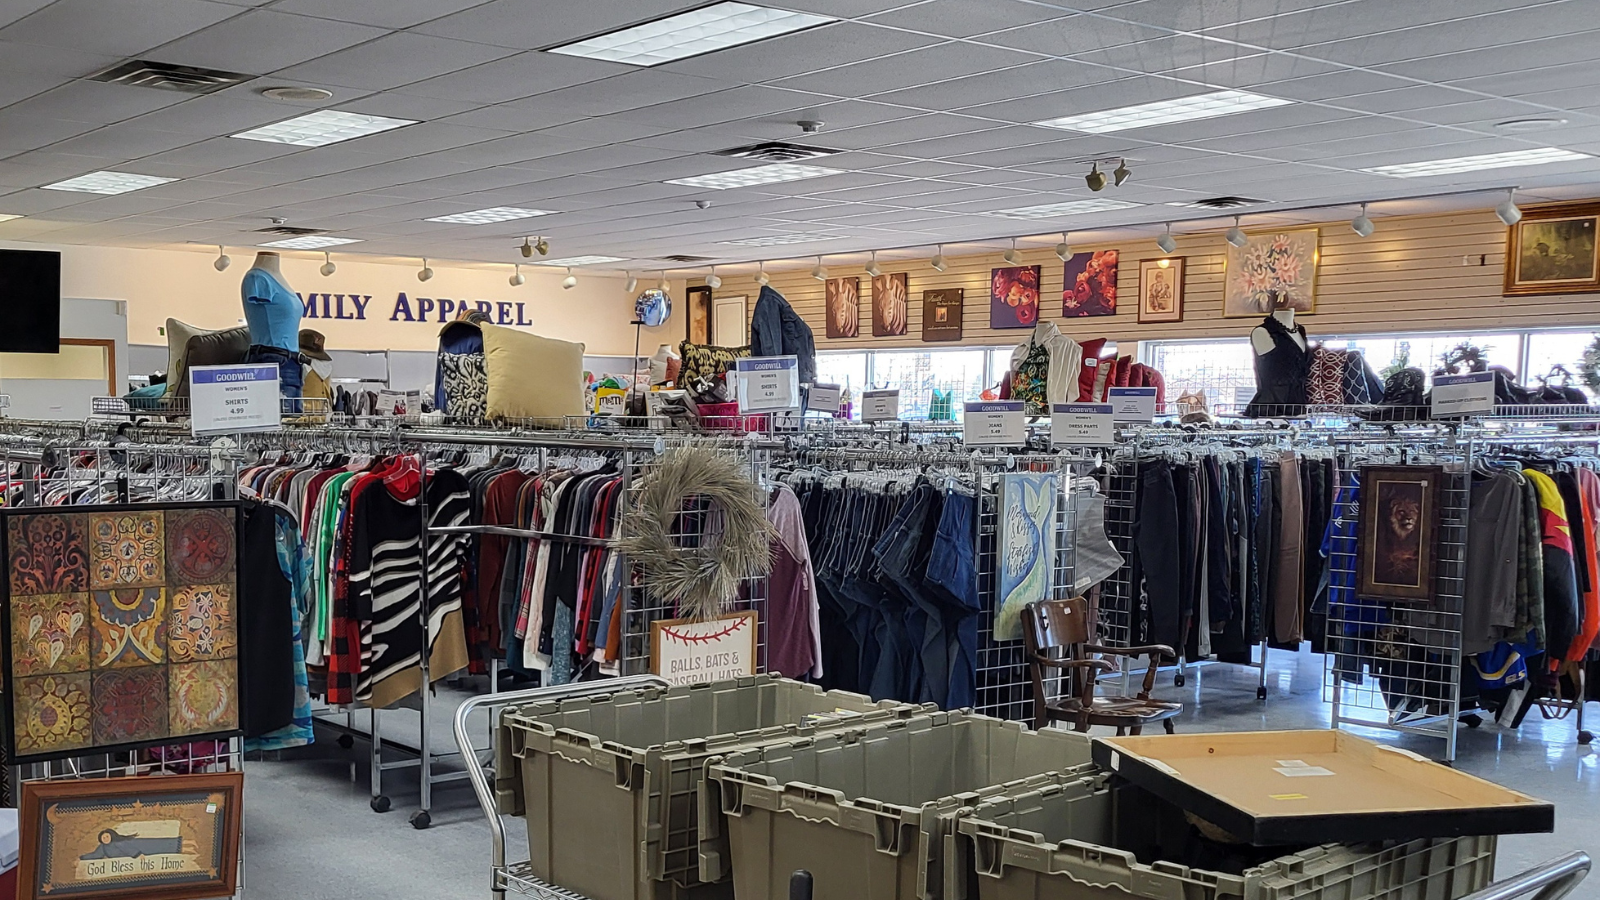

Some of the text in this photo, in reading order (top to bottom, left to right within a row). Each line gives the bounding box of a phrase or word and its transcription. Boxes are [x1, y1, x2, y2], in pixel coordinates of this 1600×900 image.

[296, 292, 533, 326] MILY APPAREL
[216, 372, 256, 382] GOODWILL
[225, 398, 249, 406] SHIRTS
[671, 651, 739, 673] BALLS, BATS &
[87, 856, 185, 877] God Bless this Home
